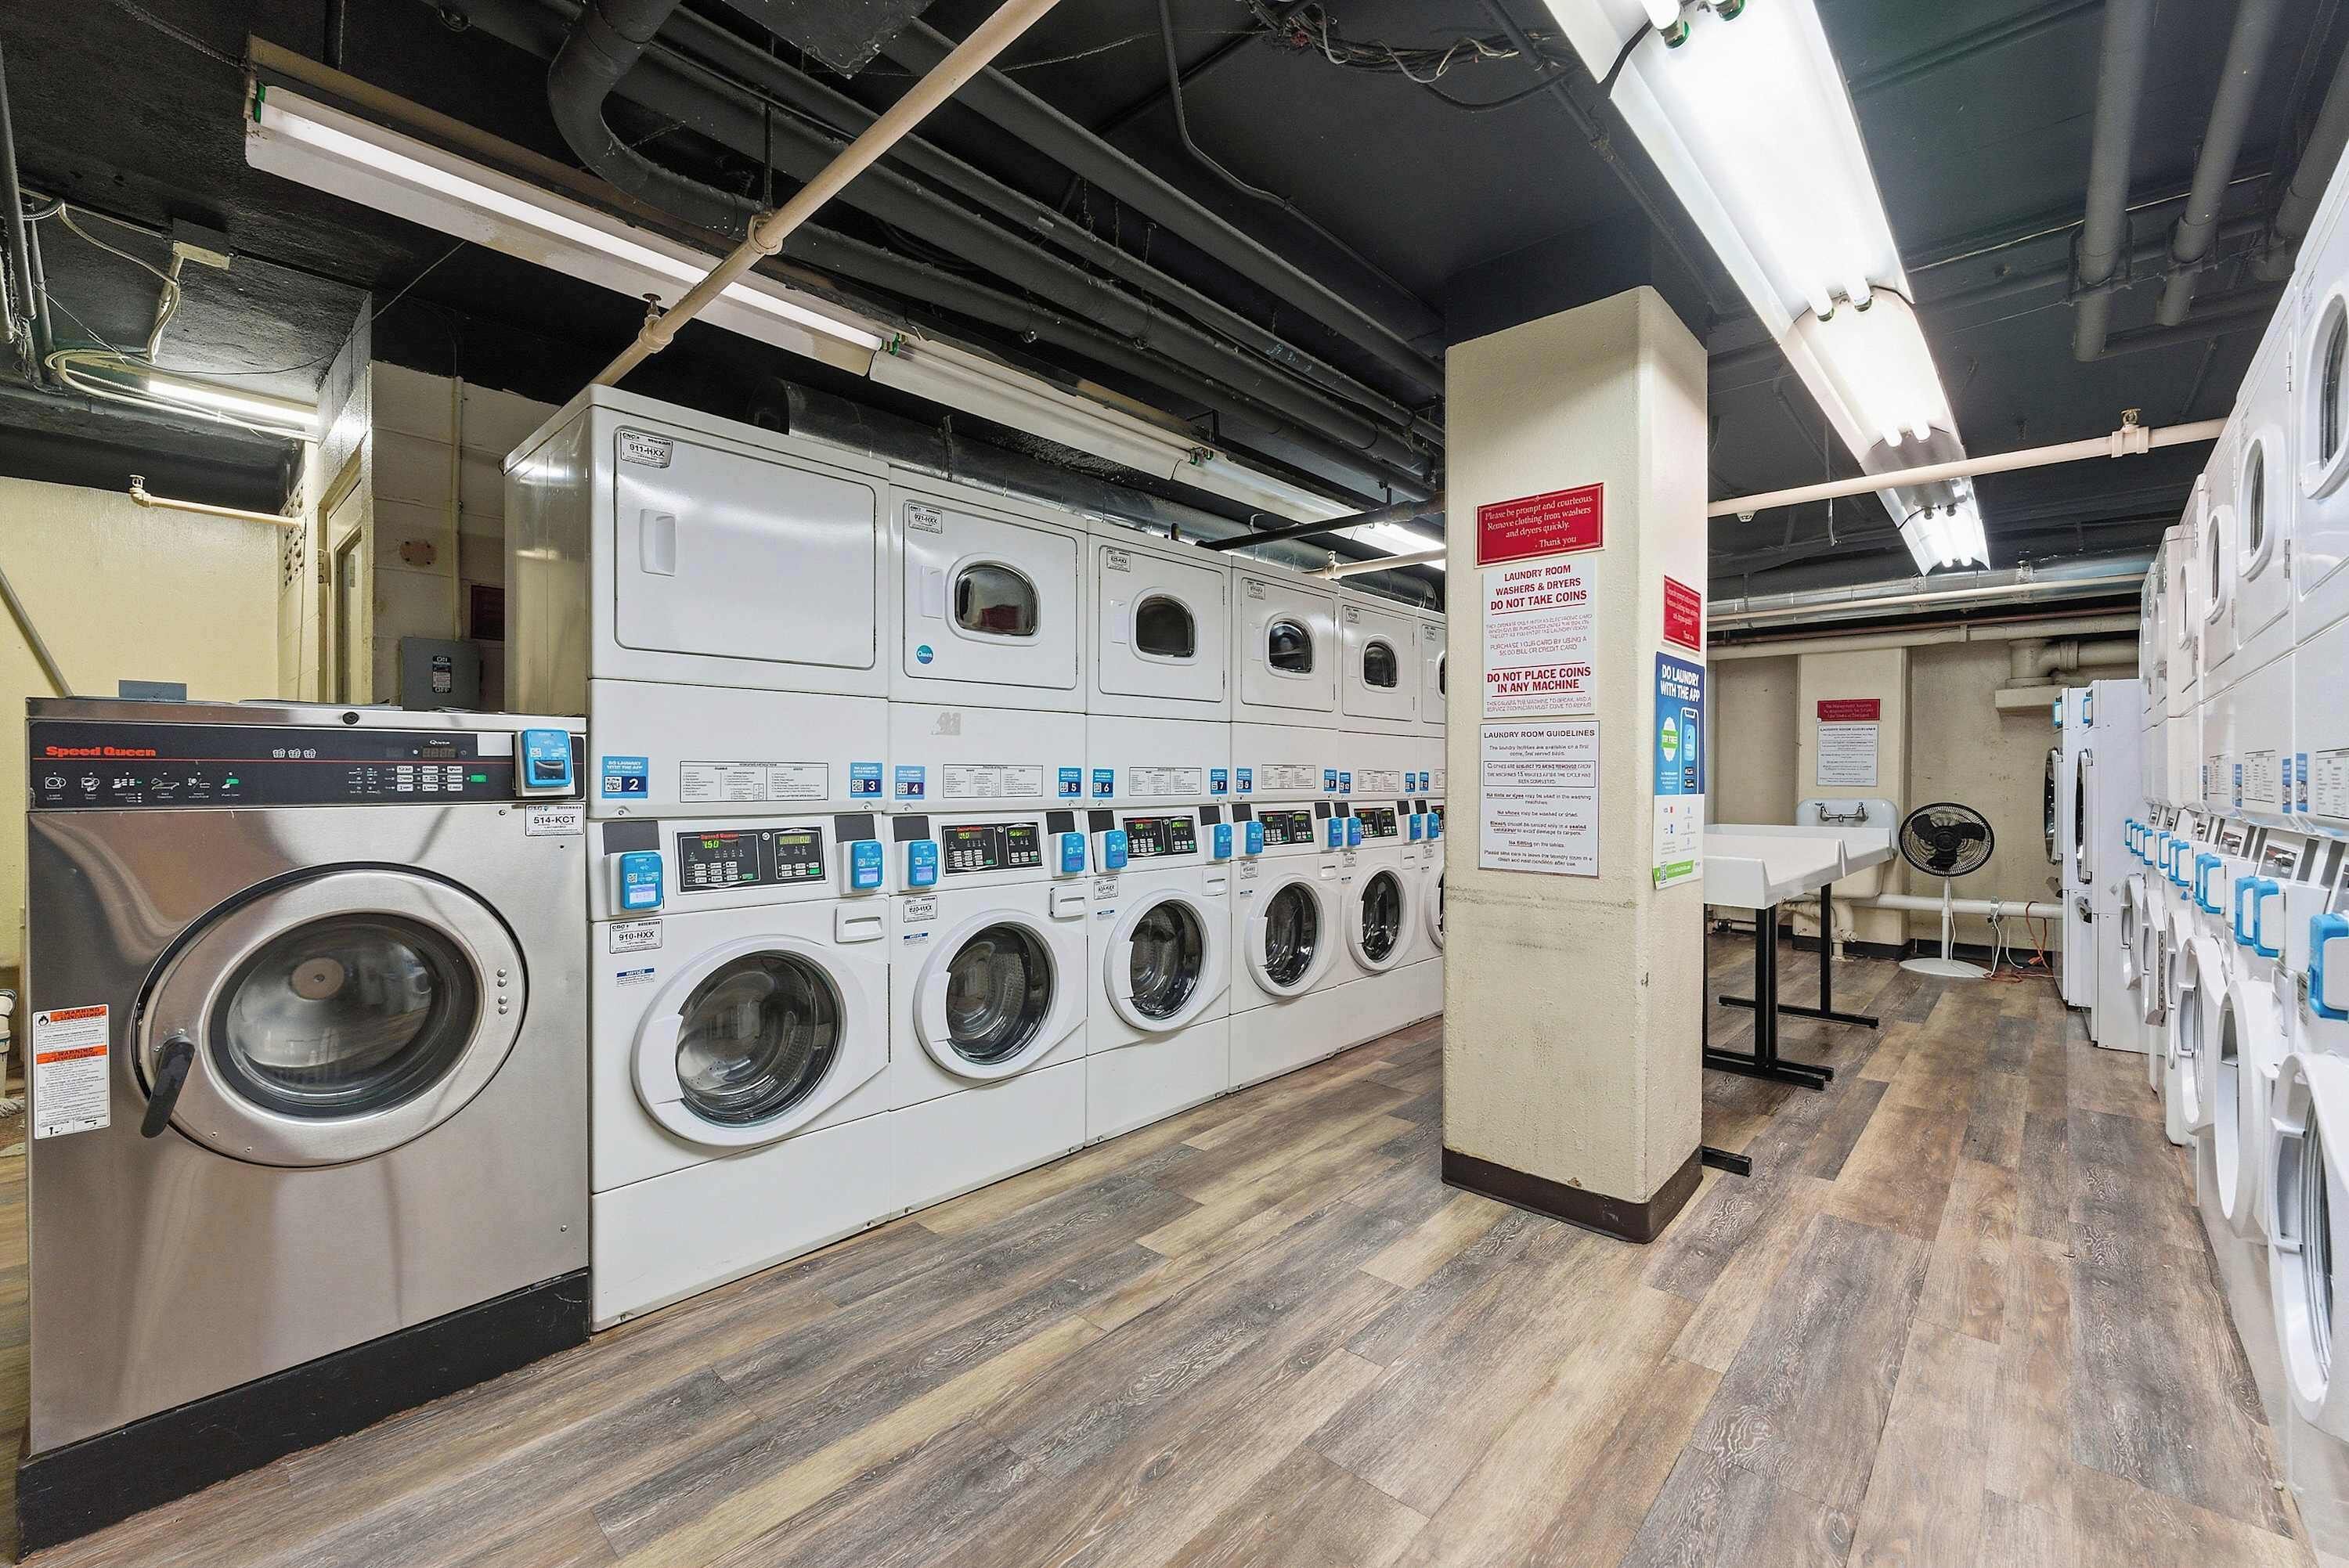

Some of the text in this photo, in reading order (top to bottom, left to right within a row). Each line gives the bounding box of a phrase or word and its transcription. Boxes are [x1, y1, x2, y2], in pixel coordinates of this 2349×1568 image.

[1485, 512, 1505, 521] Please
[1516, 505, 1541, 517] prompt
[1488, 506, 1591, 531] Remove clothing from washers
[1506, 528, 1518, 538] and
[1519, 527, 1542, 537] dryers
[1539, 536, 1576, 548] Thank you
[1504, 564, 1571, 582] LAUNDRY ROOM
[1496, 578, 1581, 596] WASHERS & DRYERS
[1491, 590, 1587, 610] DO NOT TAKE COINS
[1491, 642, 1519, 651] PURCHASE
[1487, 667, 1591, 683] DO NOT PLACE COINS
[1662, 664, 1699, 687] DO LAUNDRY
[1497, 679, 1579, 693] IN ANY MACHINE
[1660, 680, 1700, 702] WITH THE APP
[45, 746, 156, 757] Speed Queen
[629, 778, 639, 790] 2
[868, 781, 875, 791] 3
[911, 784, 918, 794] 4
[1104, 783, 1109, 791] 6
